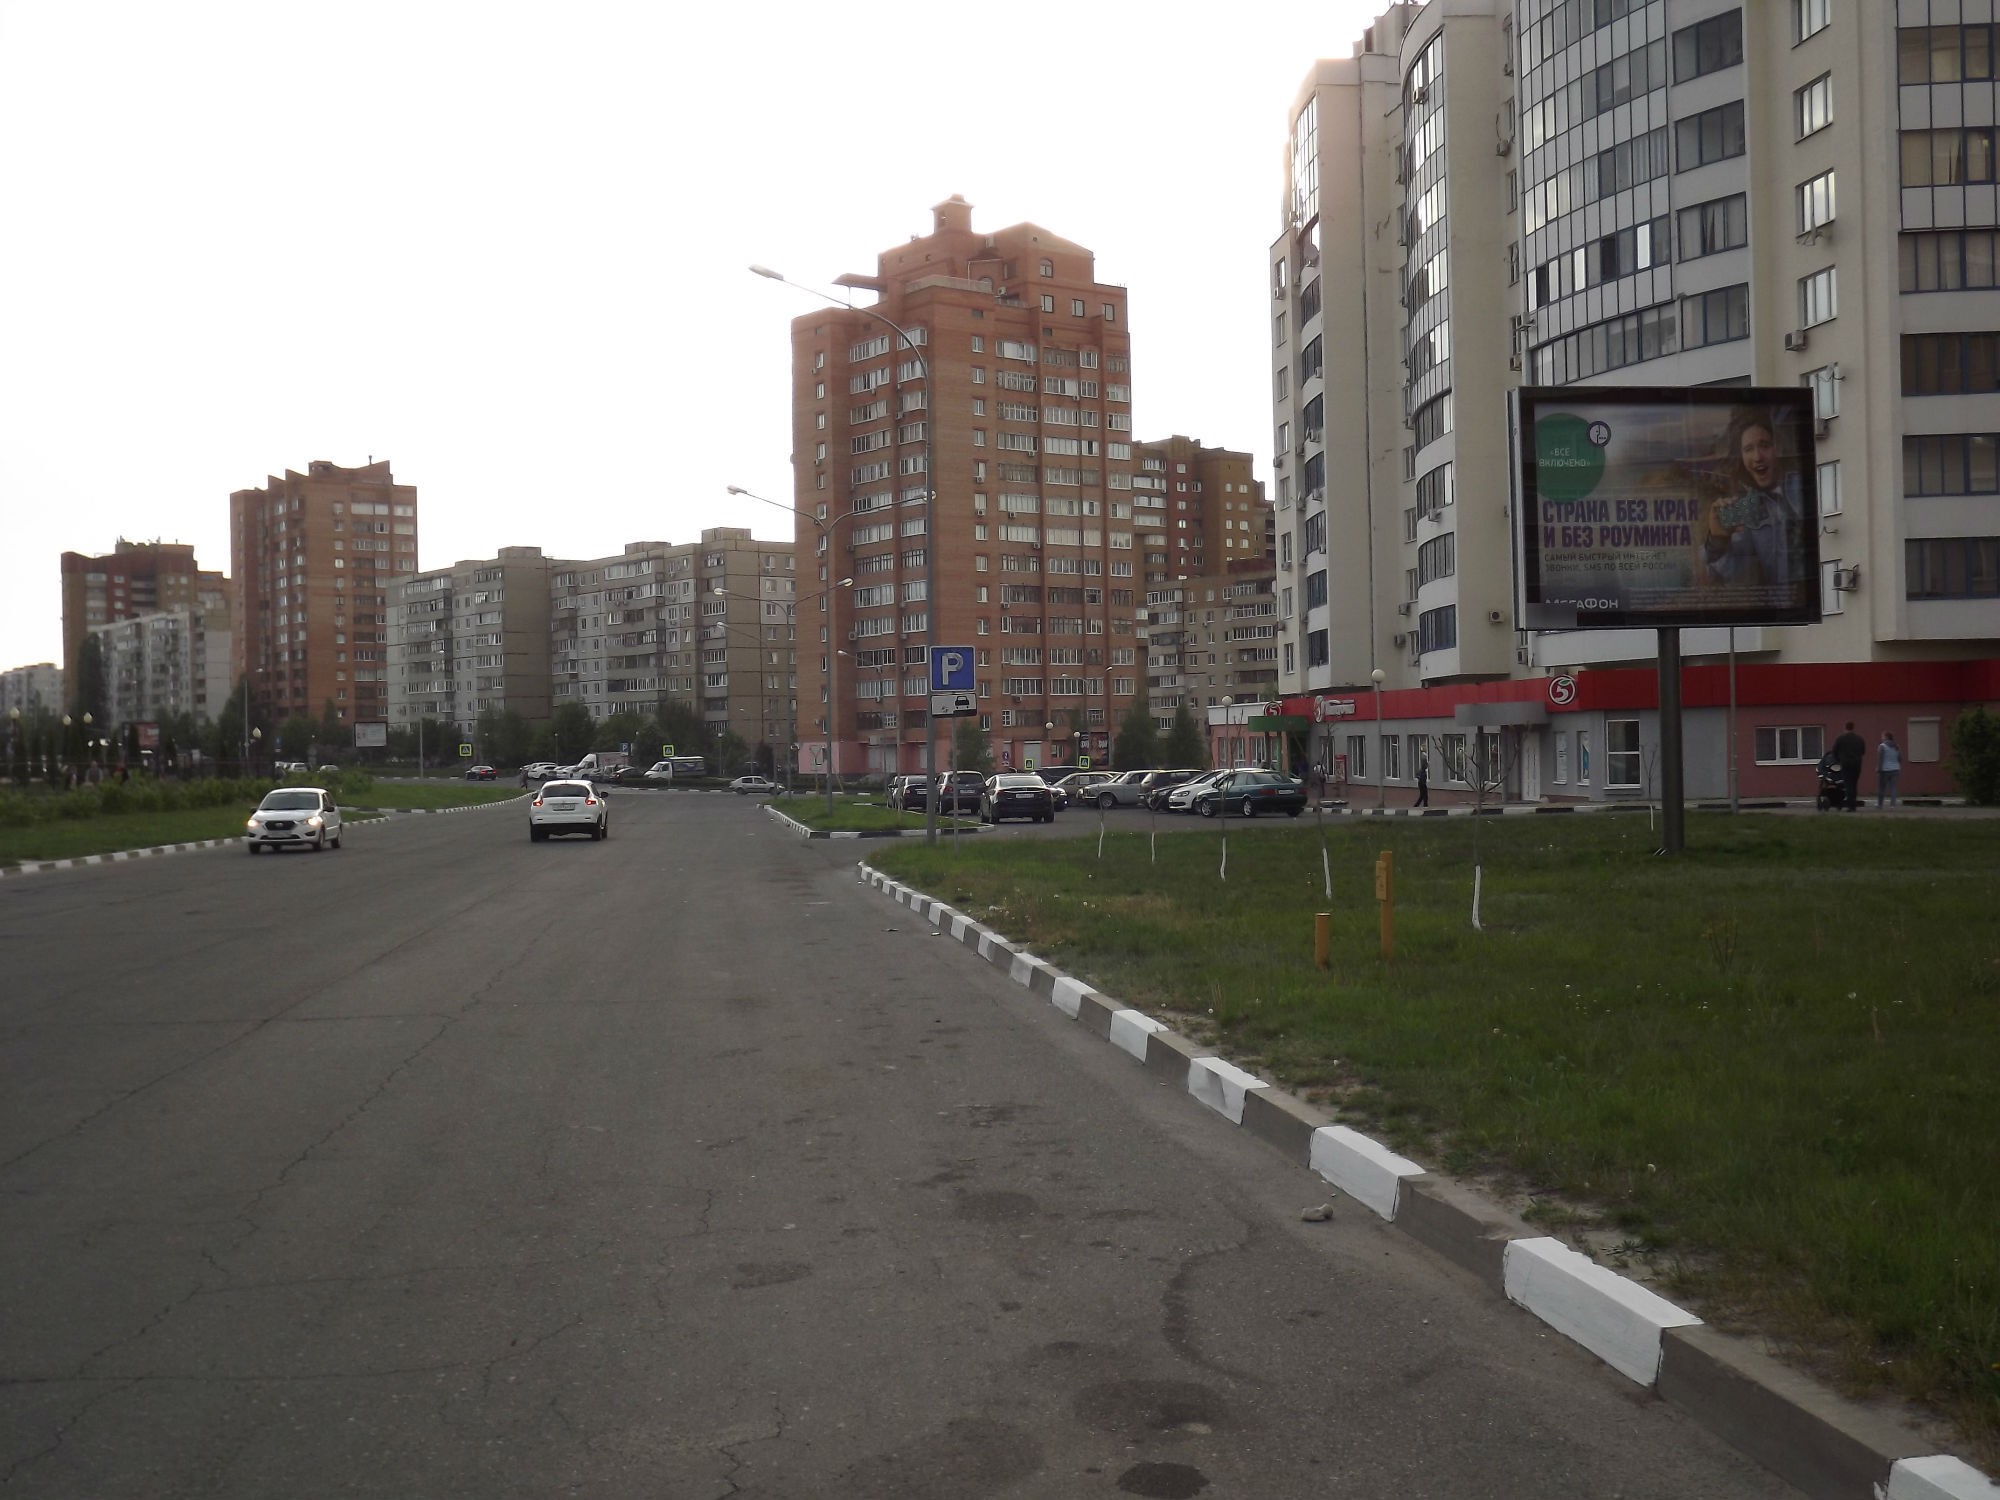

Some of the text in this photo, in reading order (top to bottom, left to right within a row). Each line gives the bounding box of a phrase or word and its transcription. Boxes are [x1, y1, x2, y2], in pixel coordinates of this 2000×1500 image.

[1542, 499, 1699, 523] СТРАНА БЕЗ КРАЯ
[1543, 525, 1692, 548] И БЕЗ РОУМИНГА
